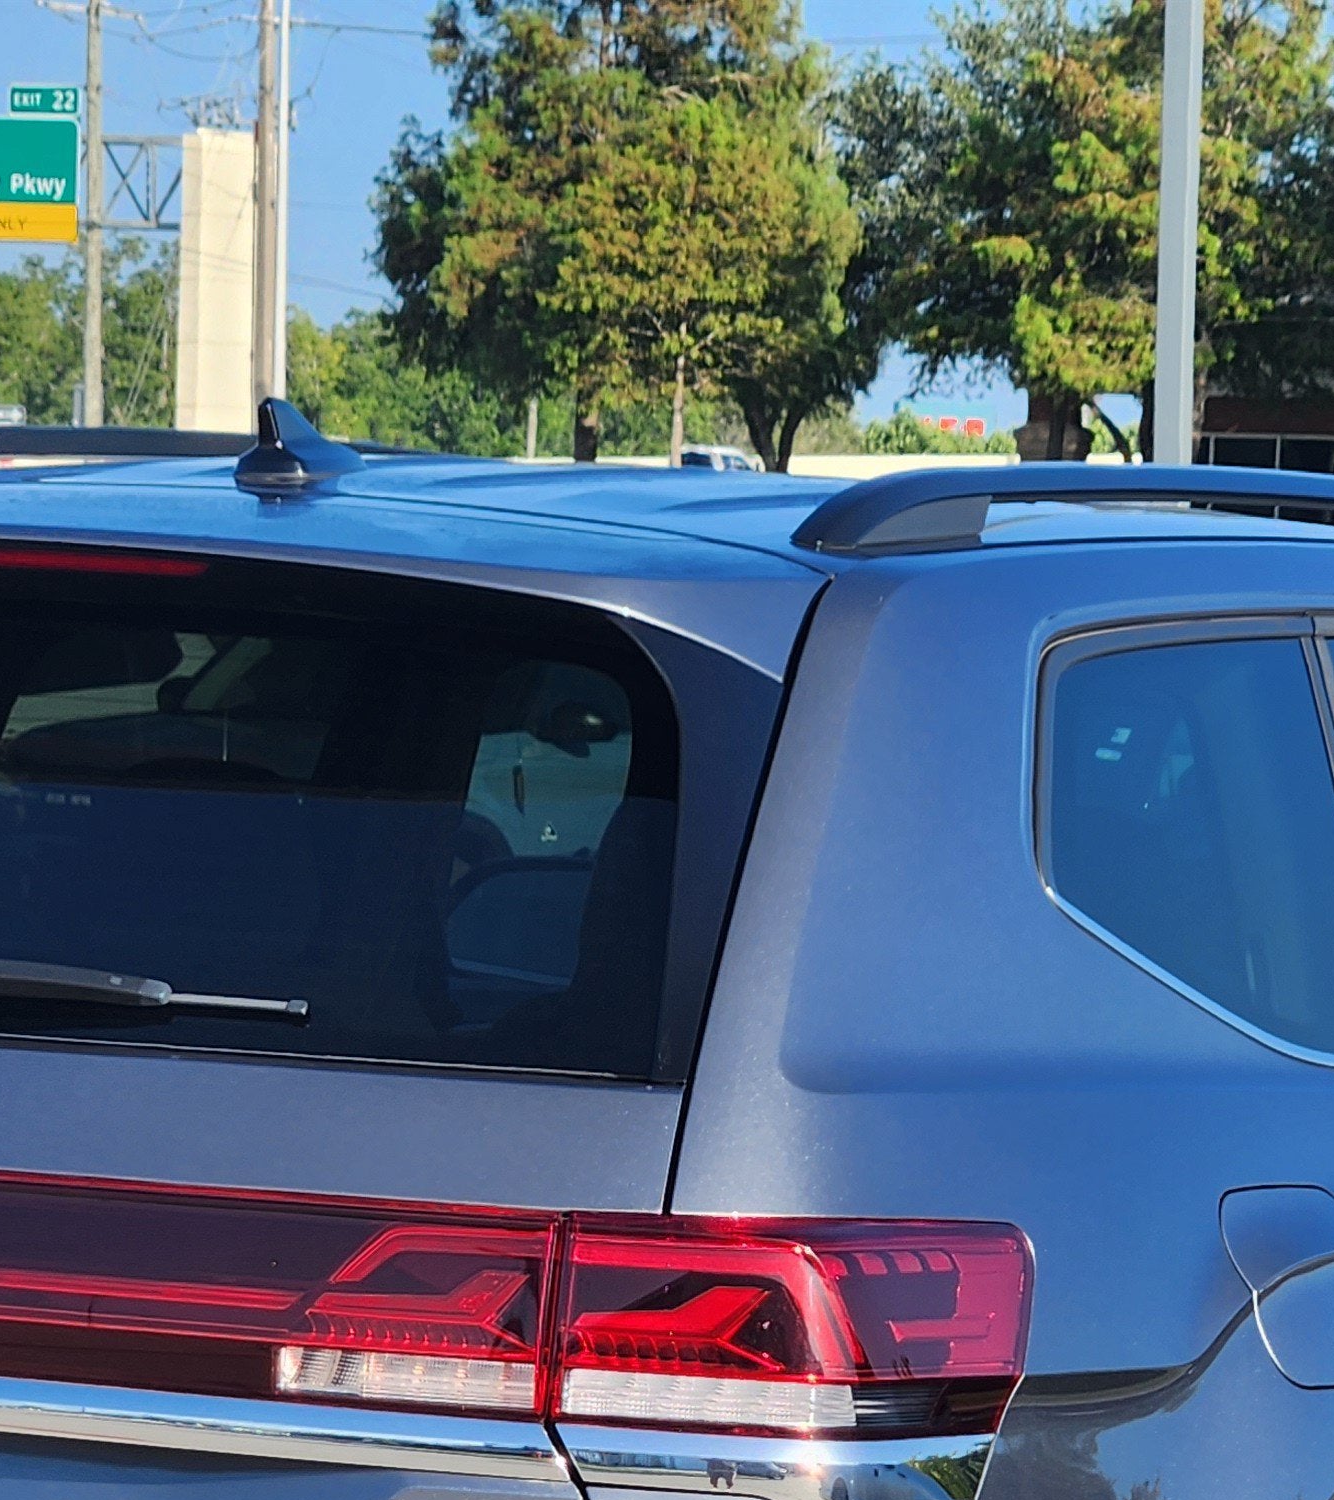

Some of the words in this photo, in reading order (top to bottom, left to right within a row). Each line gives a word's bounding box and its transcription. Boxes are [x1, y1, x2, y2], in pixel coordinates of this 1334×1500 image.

[13, 91, 42, 108] EXIT
[51, 90, 76, 111] 22
[10, 172, 66, 201] Pkwy
